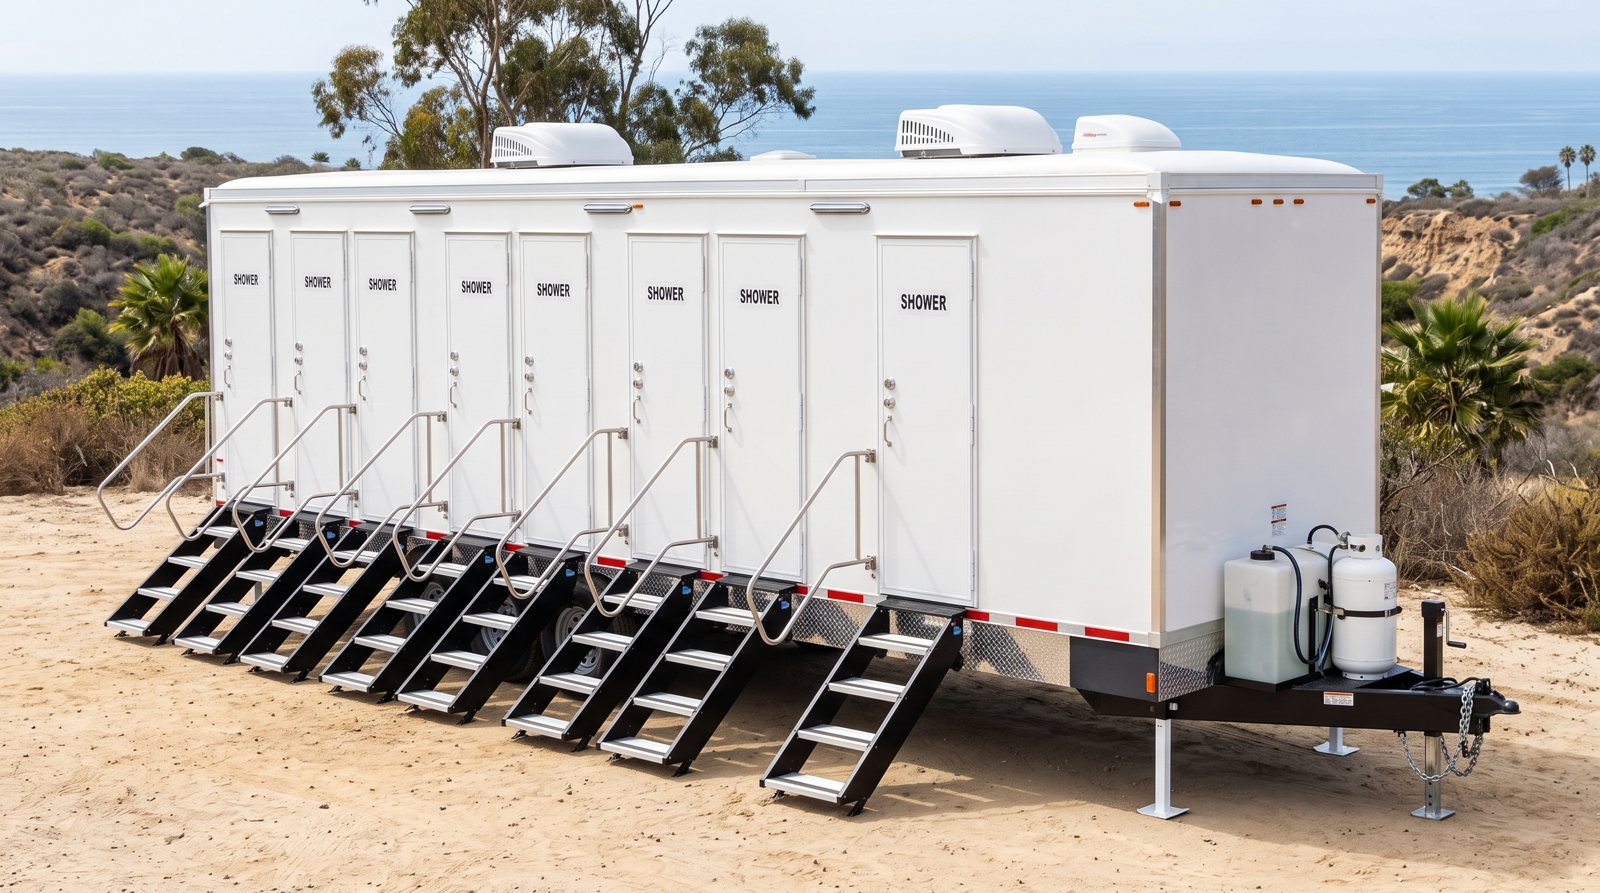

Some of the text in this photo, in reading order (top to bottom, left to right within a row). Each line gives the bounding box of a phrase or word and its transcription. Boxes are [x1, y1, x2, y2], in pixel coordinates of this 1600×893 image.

[234, 273, 258, 286] SHOWER
[305, 276, 331, 289] SHOWER
[369, 278, 397, 291] SHOWER
[462, 280, 492, 295] SHOWER
[537, 283, 570, 298] SHOWER
[648, 285, 685, 302] SHOWER
[740, 289, 779, 305] SHOWER
[901, 293, 947, 311] SHOWER
